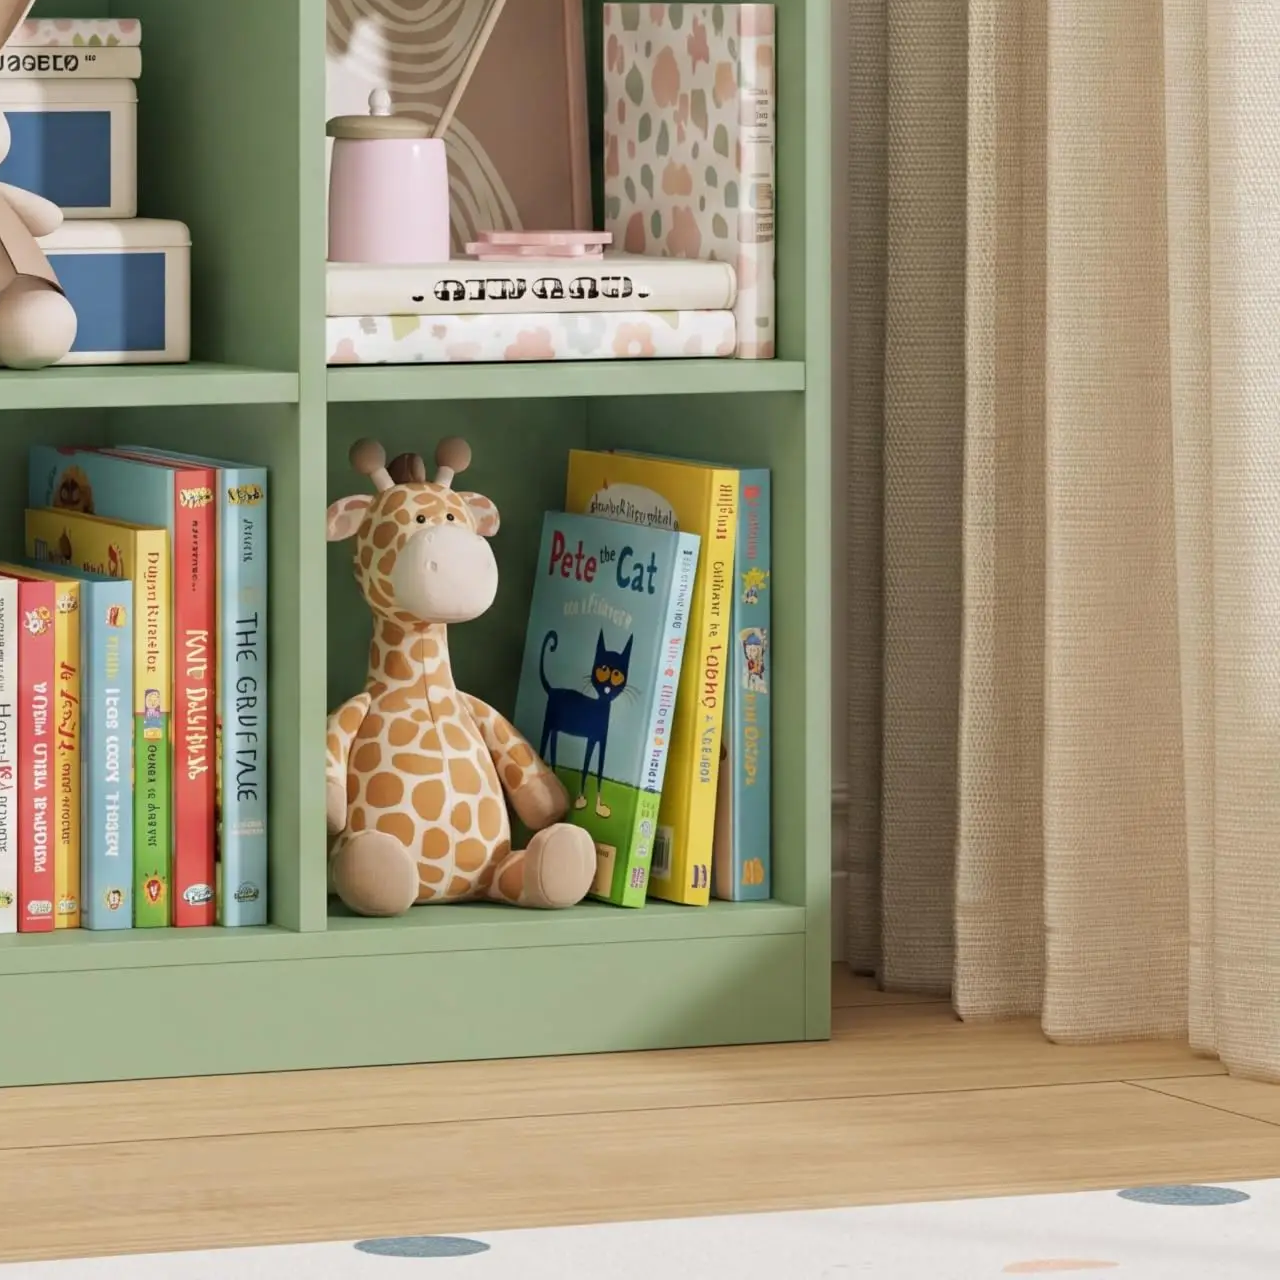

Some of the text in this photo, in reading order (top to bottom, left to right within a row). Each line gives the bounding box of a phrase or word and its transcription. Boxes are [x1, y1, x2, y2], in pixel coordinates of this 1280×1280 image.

[548, 530, 657, 595] Pete the Cat
[235, 612, 258, 662] THE
